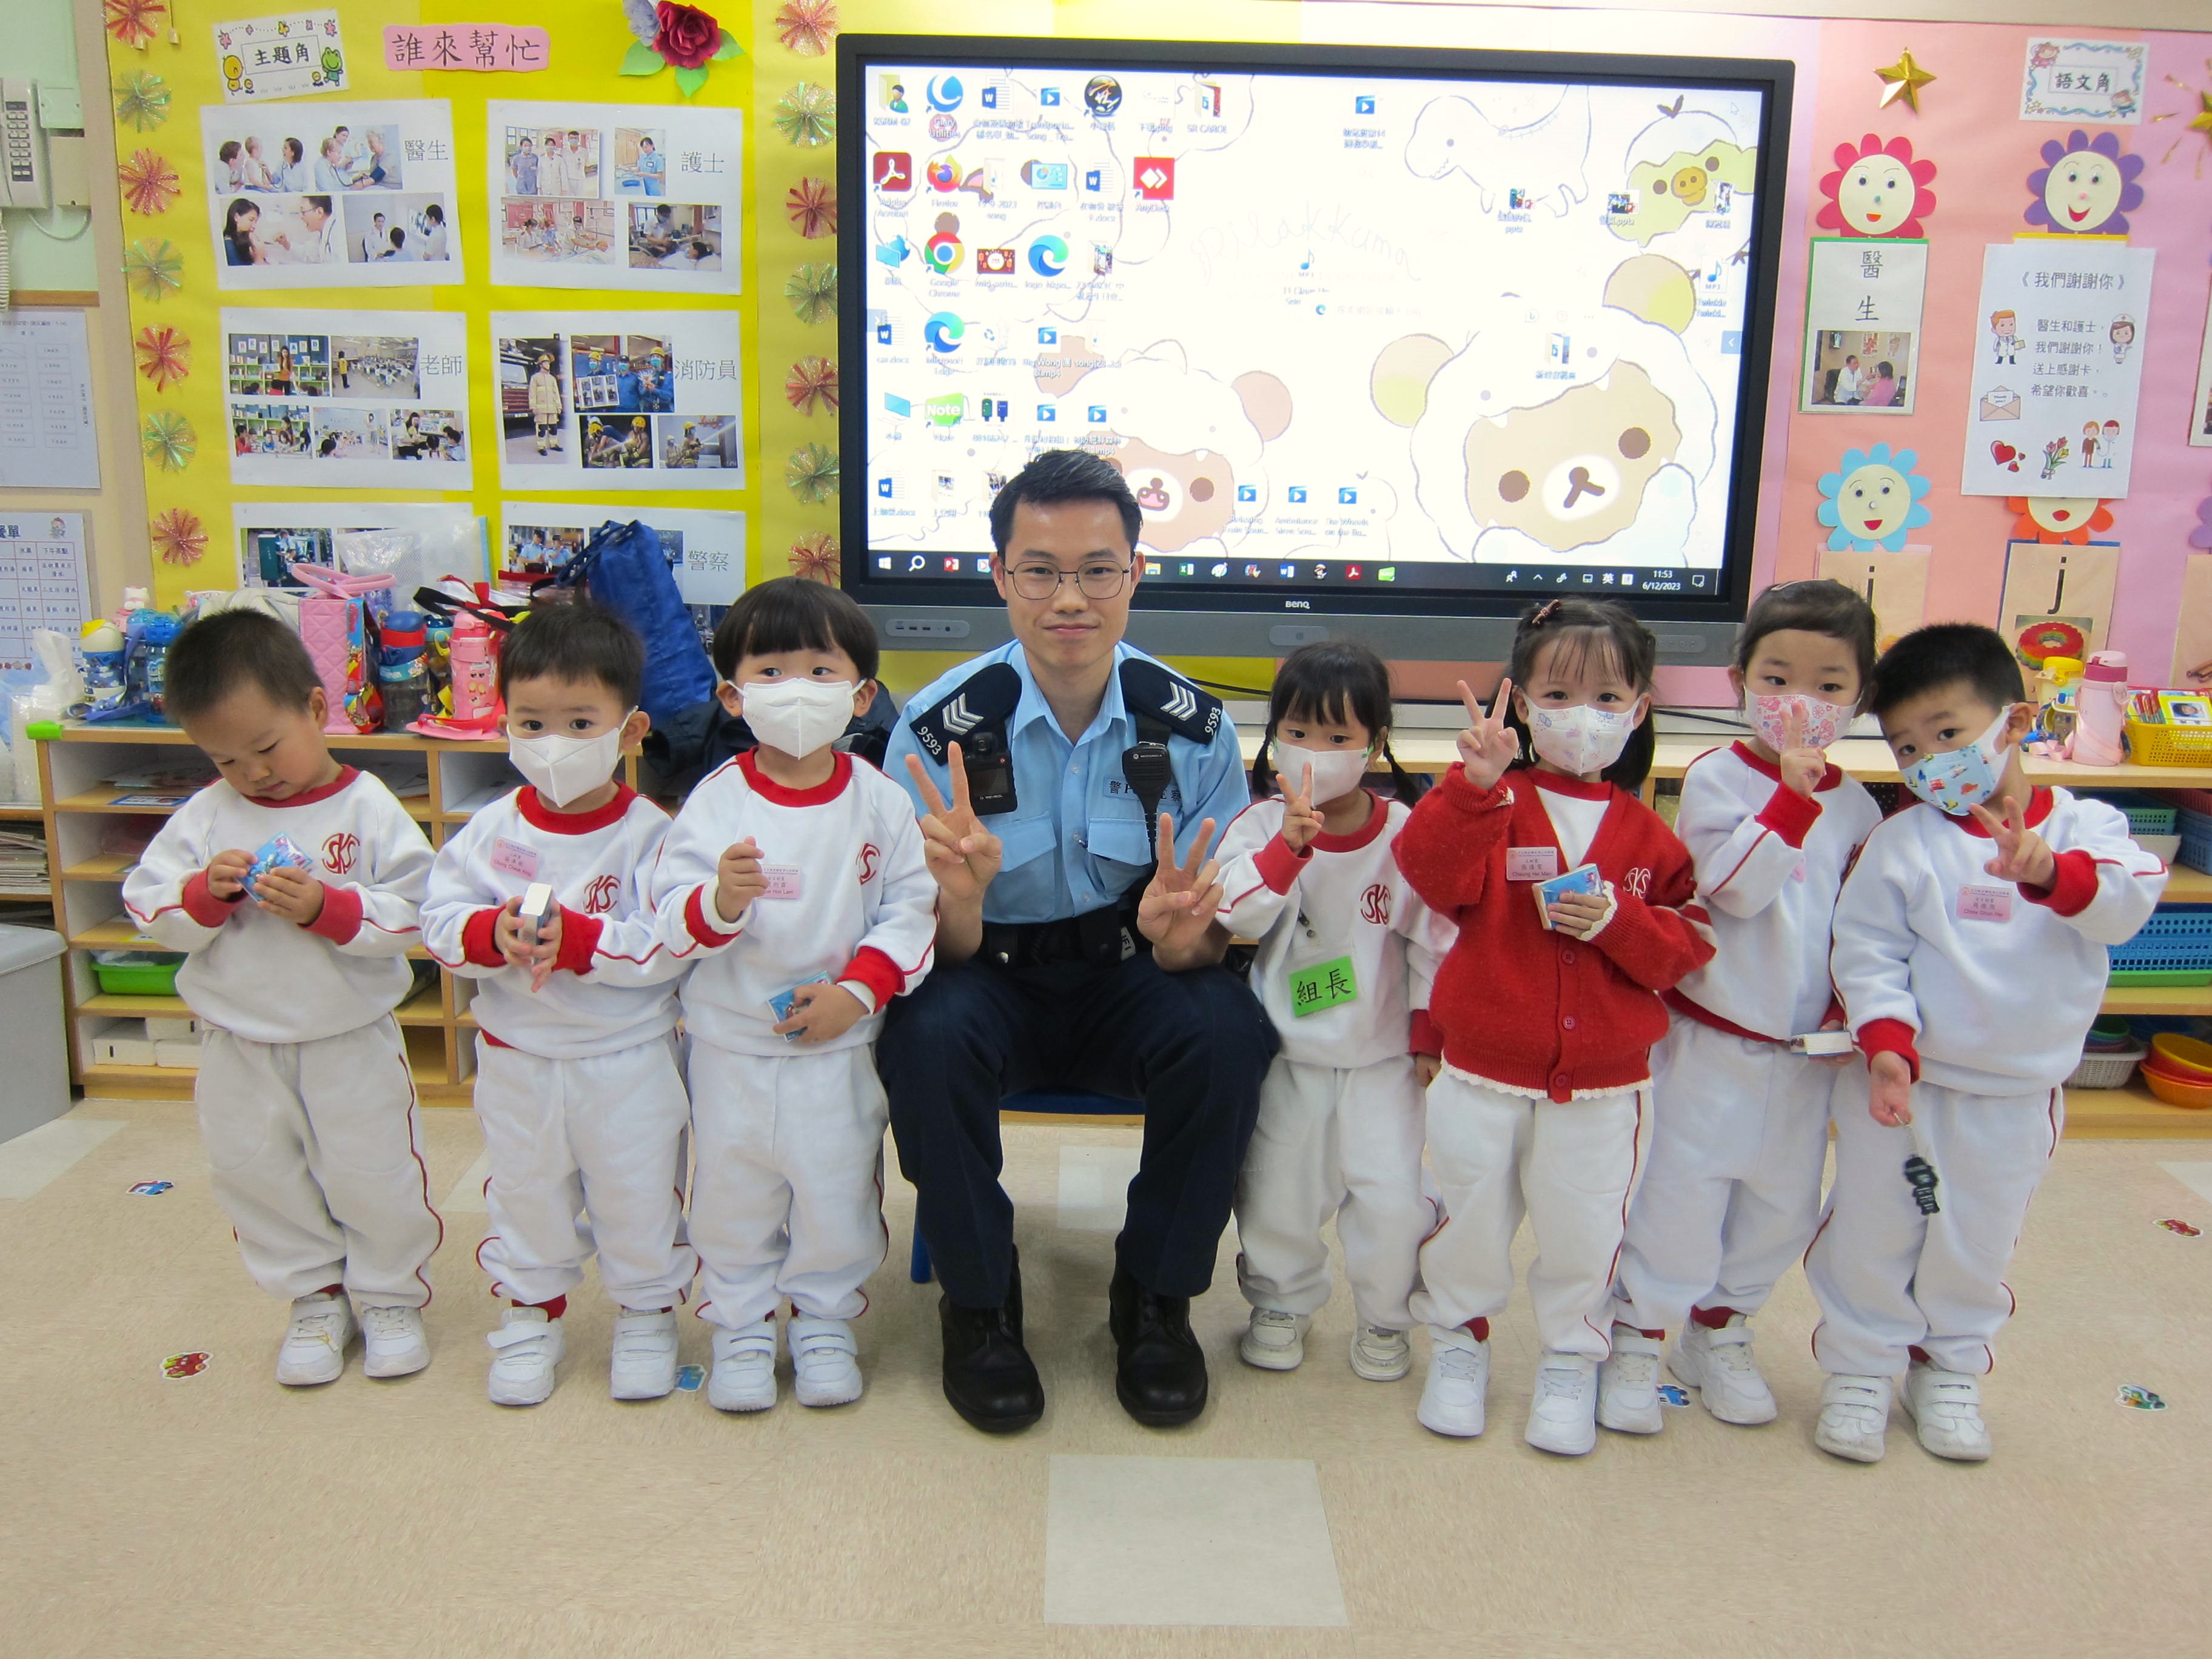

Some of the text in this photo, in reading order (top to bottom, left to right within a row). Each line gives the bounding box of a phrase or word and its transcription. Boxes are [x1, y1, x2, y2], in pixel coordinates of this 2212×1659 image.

[254, 45, 310, 67] 主題角
[392, 30, 540, 68] 誰來幫忙
[2055, 72, 2111, 93] 語文角
[405, 139, 449, 162] 醫生
[681, 151, 725, 174] 護士
[1854, 250, 1883, 321] 醫生
[420, 355, 463, 376] 老師
[674, 359, 737, 381] 消防員
[927, 404, 960, 416] Note
[688, 550, 729, 571] 警察
[1602, 572, 1615, 585] 英
[1653, 569, 1673, 578] 11:53
[1642, 581, 1681, 591] 6/12/2023
[2047, 556, 2067, 615] j
[1204, 706, 1221, 734] 9593
[916, 726, 943, 756] 9593
[1109, 780, 1121, 794] 警
[1297, 968, 1352, 1007] 組長
